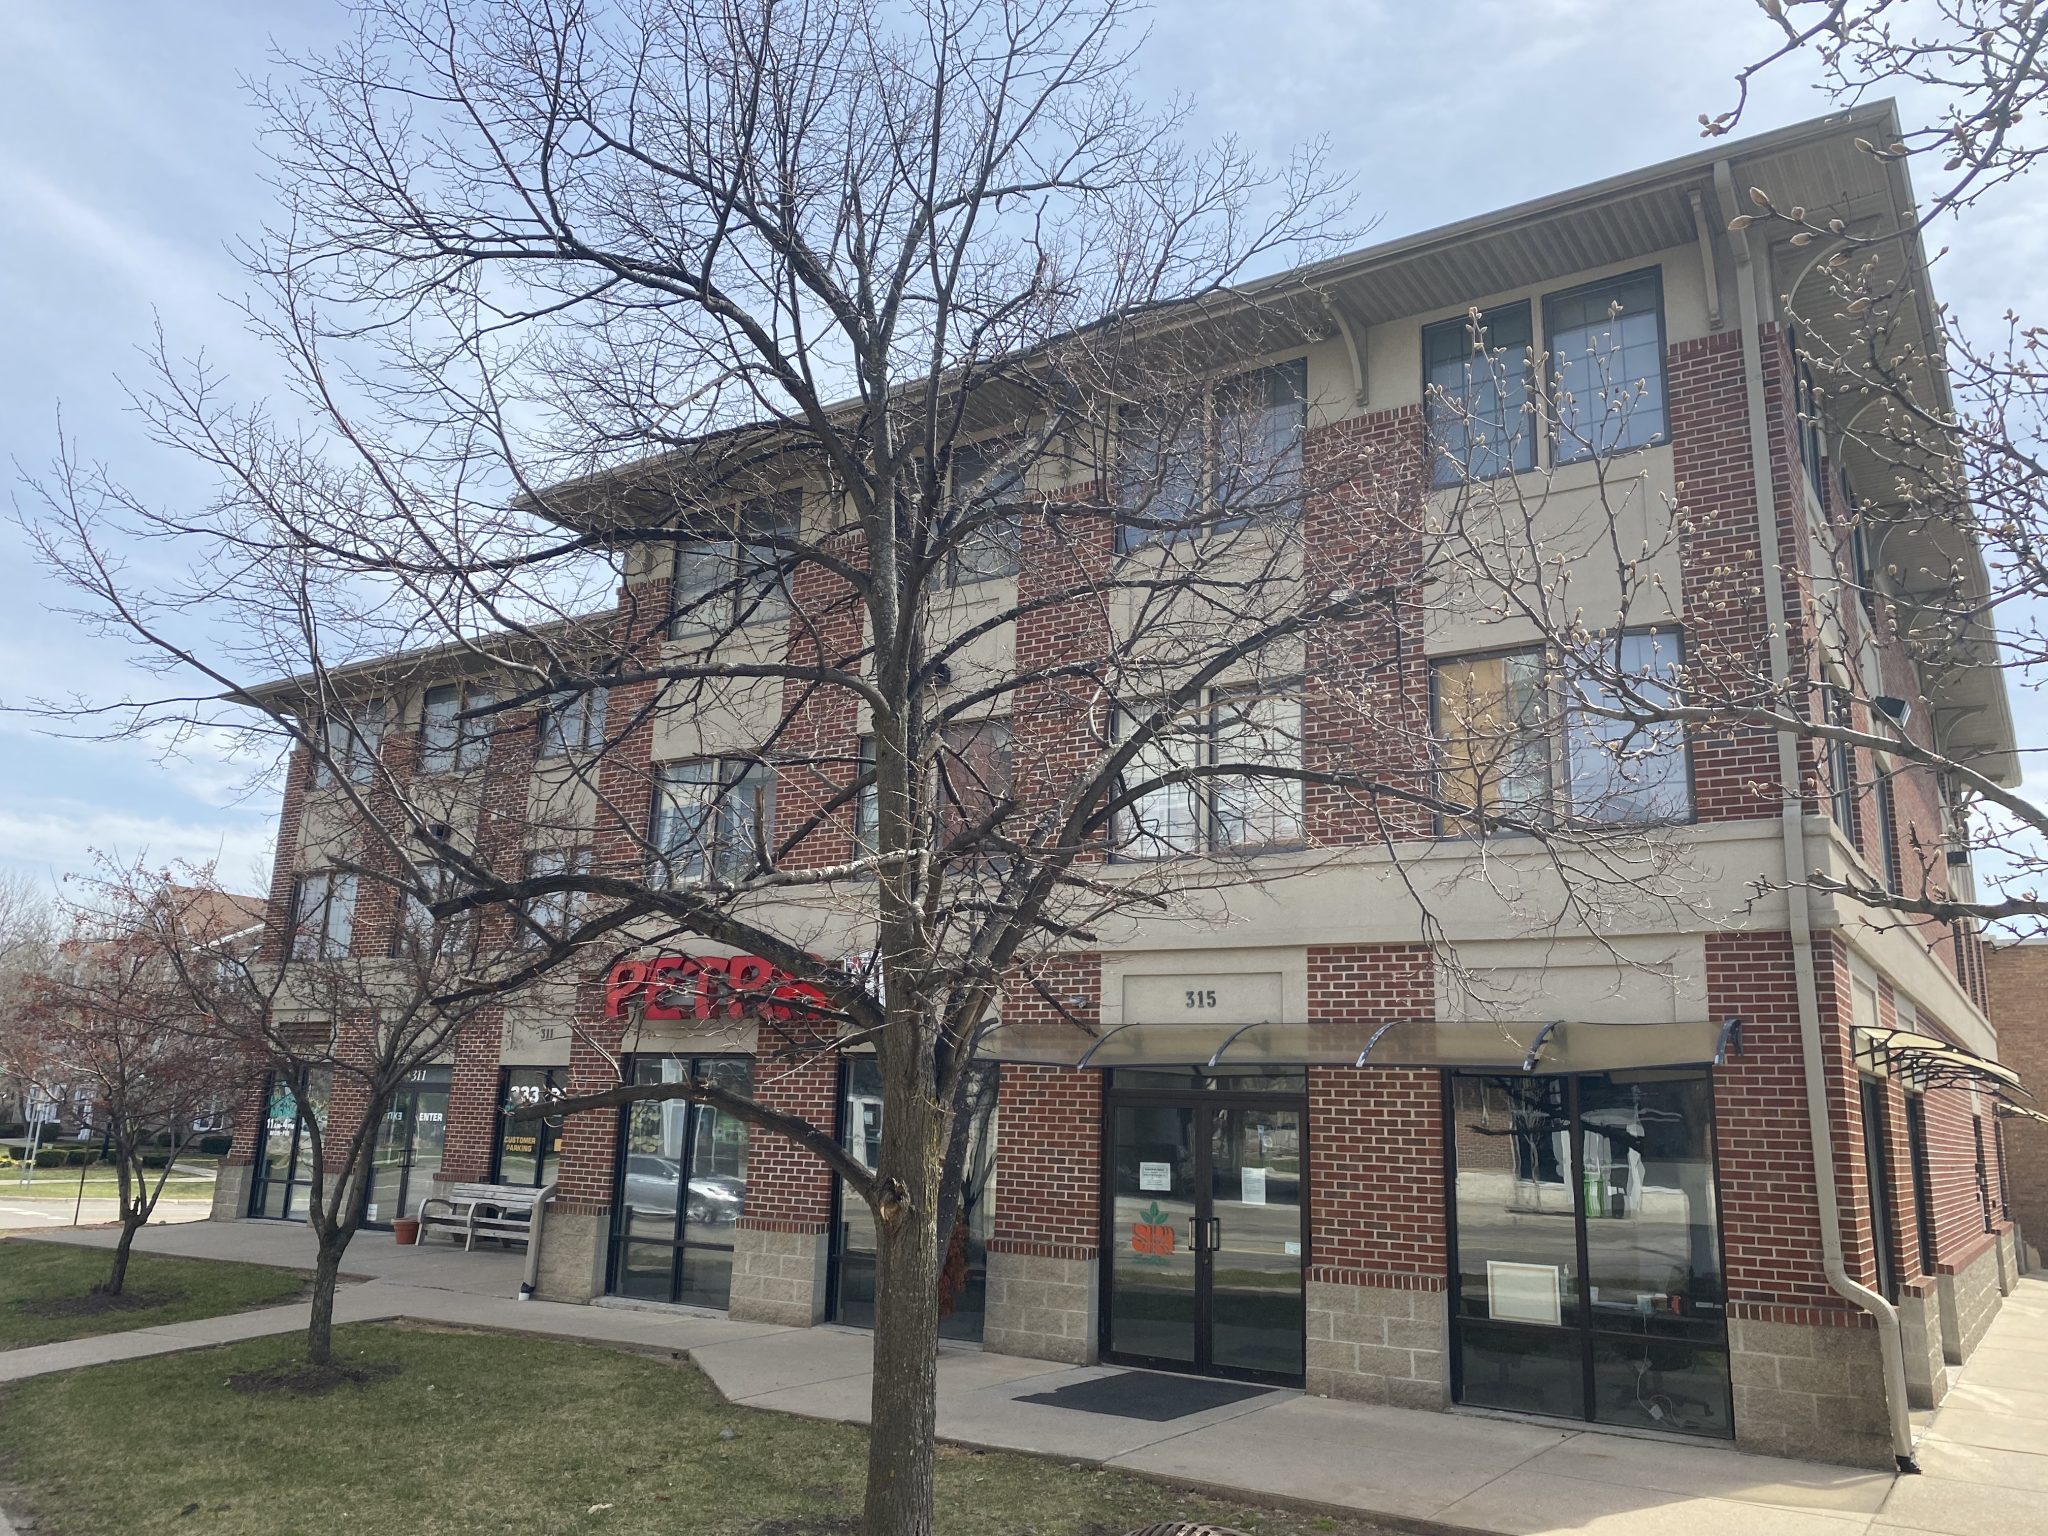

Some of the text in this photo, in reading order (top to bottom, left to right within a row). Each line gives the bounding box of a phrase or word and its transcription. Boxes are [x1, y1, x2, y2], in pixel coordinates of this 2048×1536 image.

[1185, 990, 1216, 1008] 315
[540, 1028, 553, 1039] 311
[411, 1070, 427, 1081] 311
[419, 1112, 443, 1121] ENTER
[504, 1136, 536, 1144] CUSTOMER
[506, 1144, 533, 1152] PARKING
